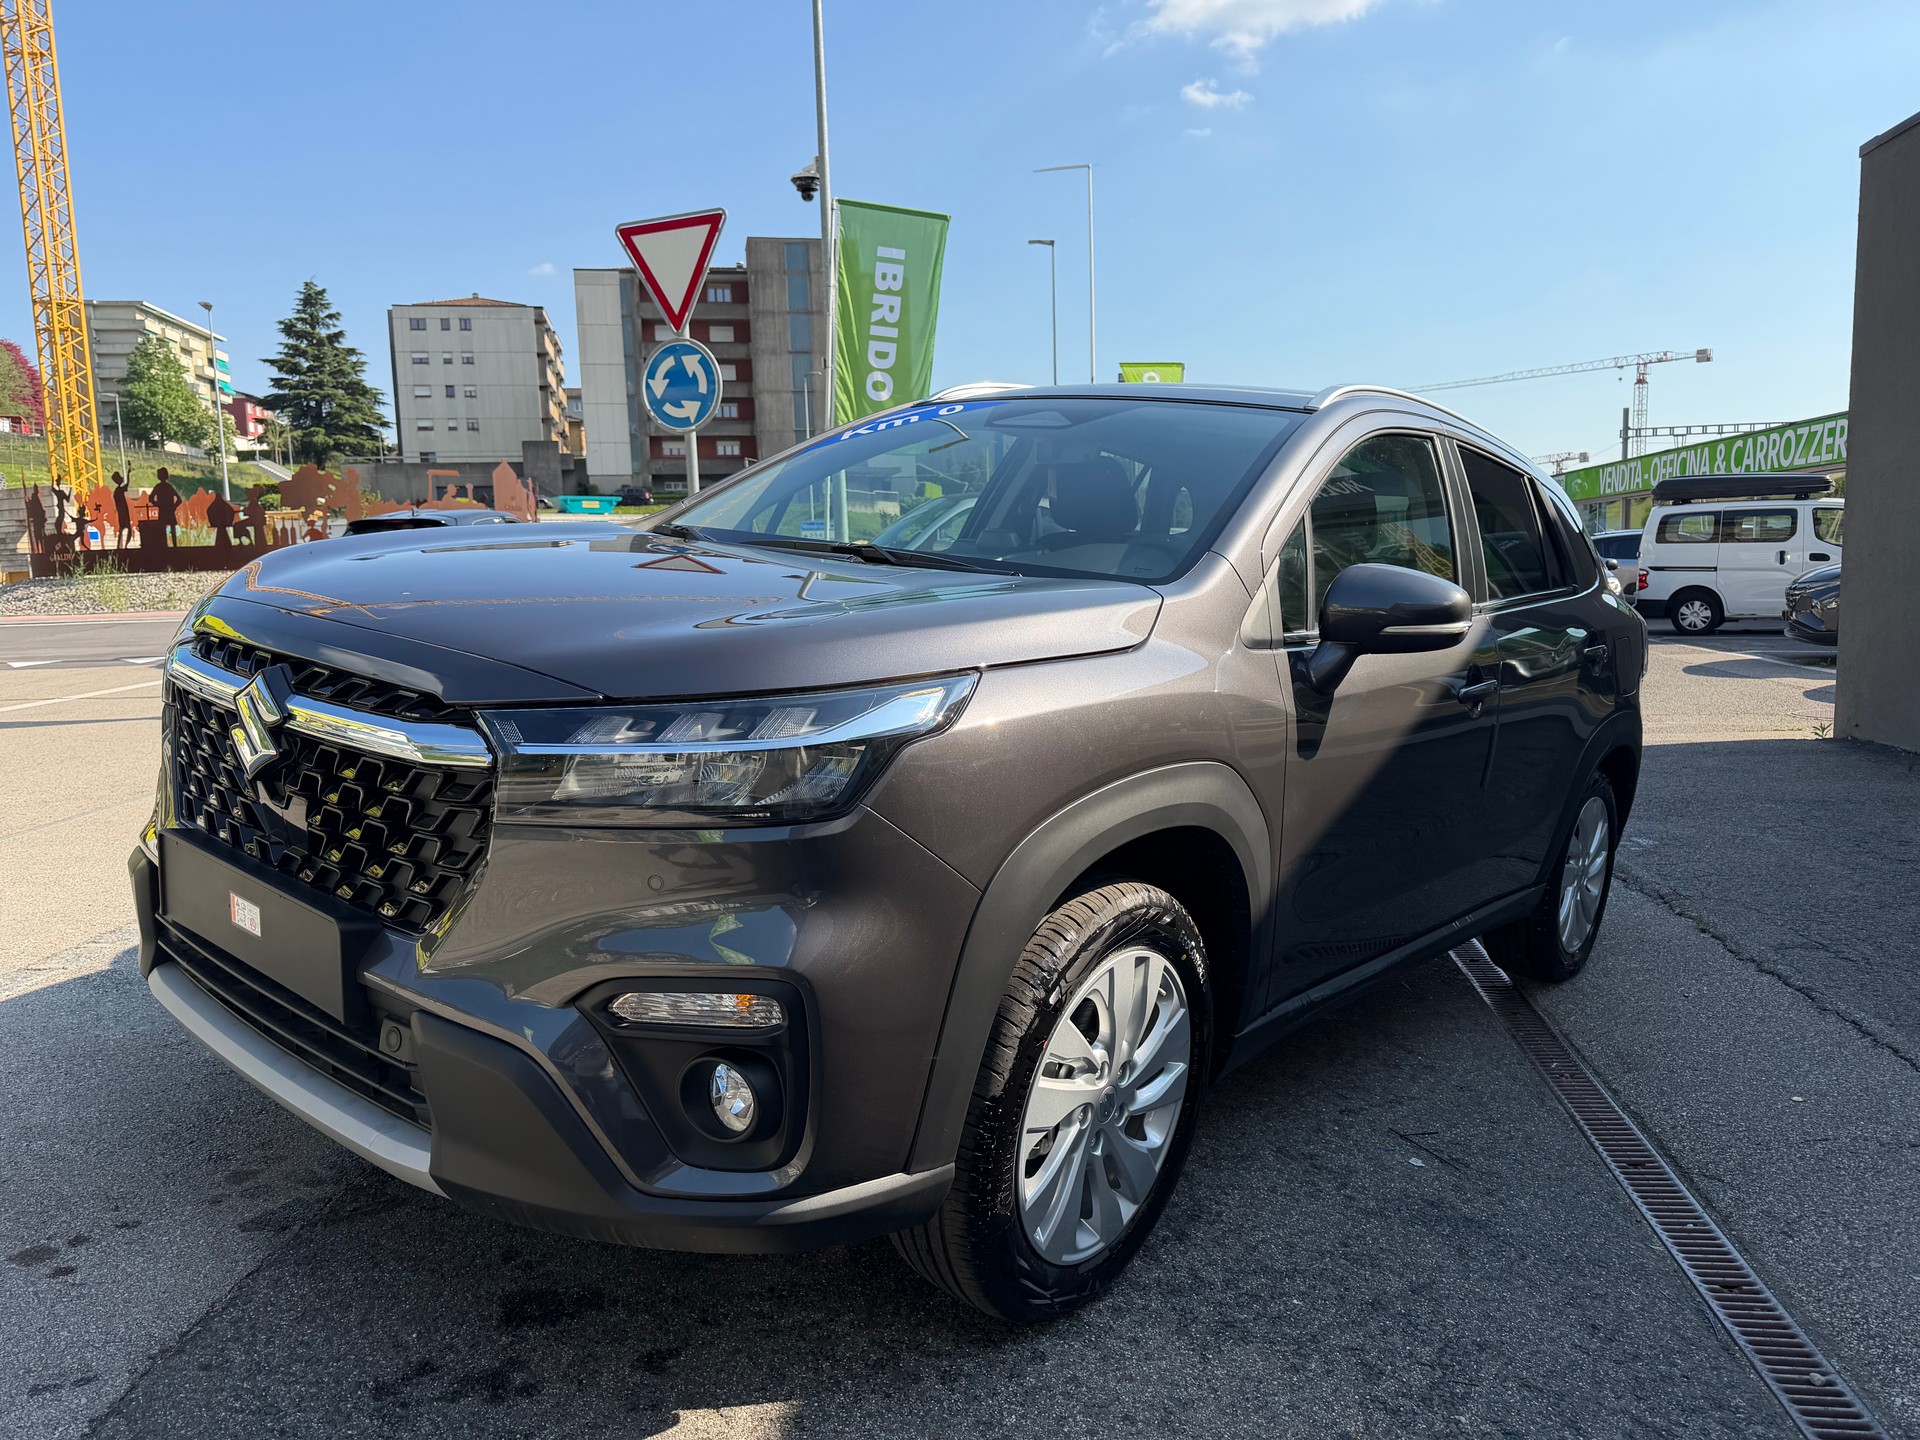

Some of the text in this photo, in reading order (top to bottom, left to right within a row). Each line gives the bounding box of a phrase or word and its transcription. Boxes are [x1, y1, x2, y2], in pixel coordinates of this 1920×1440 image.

[866, 246, 905, 401] IBRIDO
[840, 415, 920, 441] Km
[1599, 460, 1643, 495] VENDITA
[1650, 447, 1710, 487] OFFICINA
[1713, 443, 1727, 475] &
[1730, 418, 1848, 475] CARROZZER
